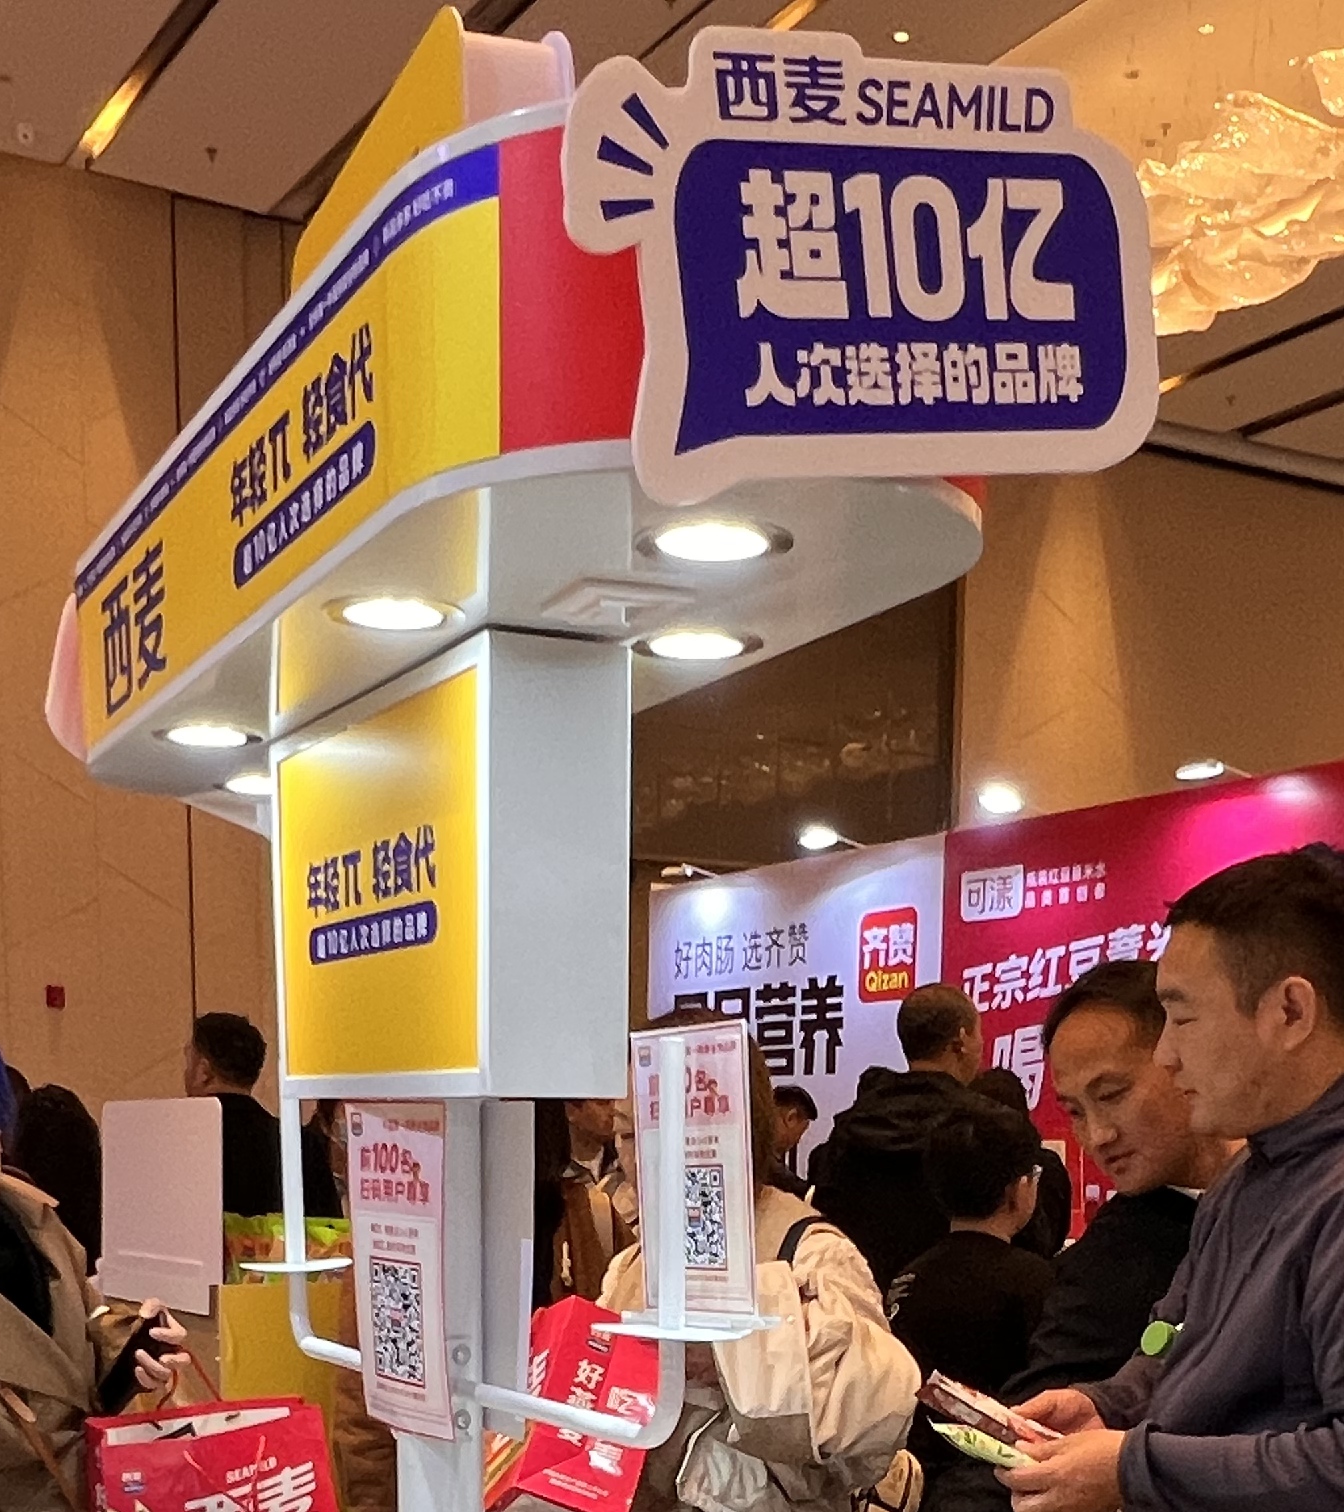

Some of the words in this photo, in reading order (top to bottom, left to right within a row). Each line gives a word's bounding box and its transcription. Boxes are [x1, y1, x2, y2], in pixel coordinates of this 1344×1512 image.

[713, 50, 847, 128] 西麦
[855, 78, 1055, 133] SEAMILD
[736, 167, 1075, 321] 超10亿
[302, 322, 374, 462] 轻食代
[743, 342, 1085, 409] 人次选择的品牌
[101, 537, 168, 717] 西麦
[372, 824, 437, 903] 轻食代
[674, 934, 735, 980] 好肉肠
[741, 922, 810, 972] 选齐赞
[862, 923, 915, 970] 齐赞
[864, 970, 910, 993] Qizan
